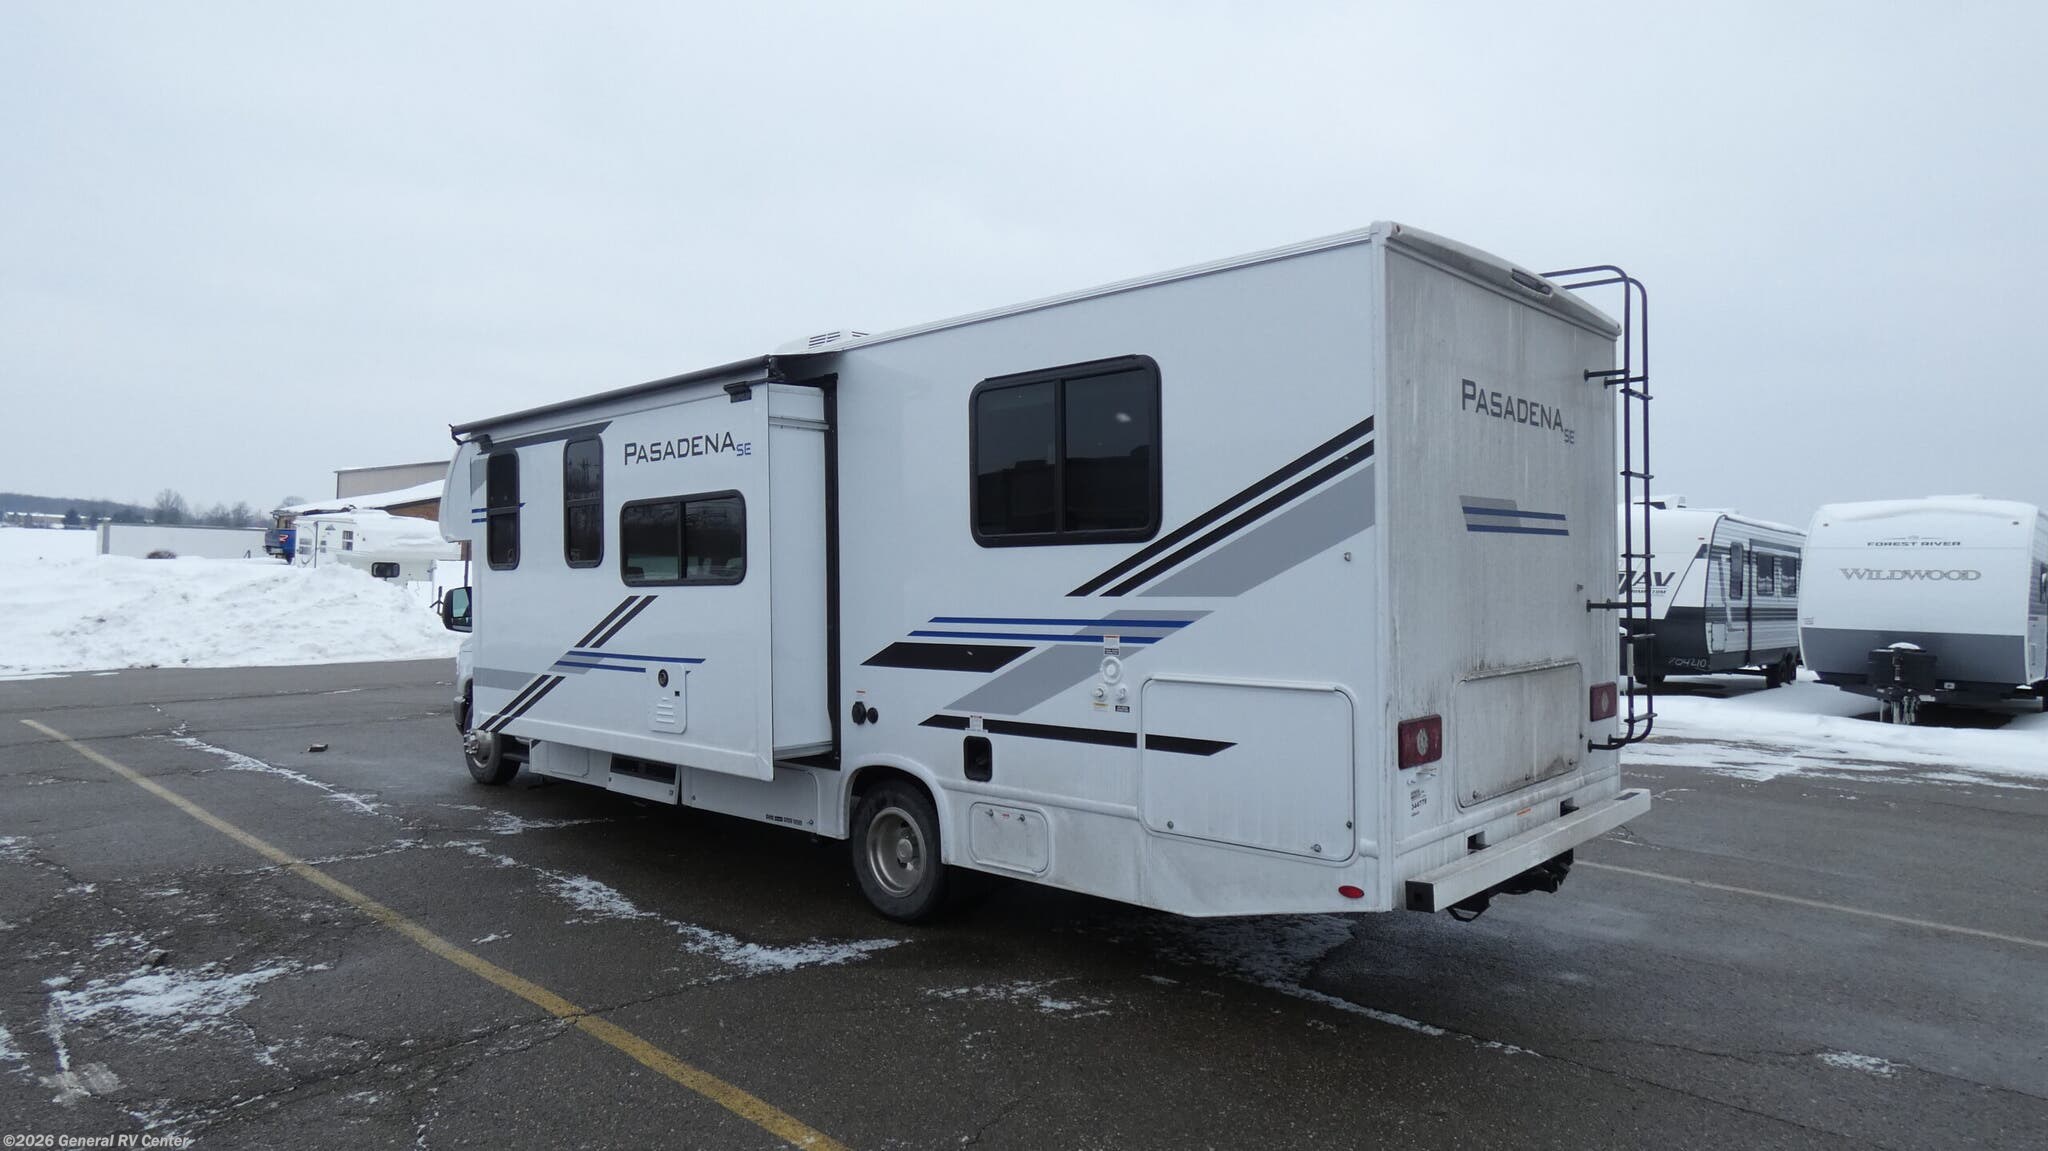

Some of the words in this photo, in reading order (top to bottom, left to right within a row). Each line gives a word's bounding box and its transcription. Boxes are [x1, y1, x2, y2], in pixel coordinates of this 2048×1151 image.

[1462, 378, 1564, 433] PASADENA
[1564, 428, 1575, 444] SE
[624, 431, 736, 466] PASADENA
[736, 442, 752, 457] SE
[1840, 568, 1982, 581] WILDWOOD
